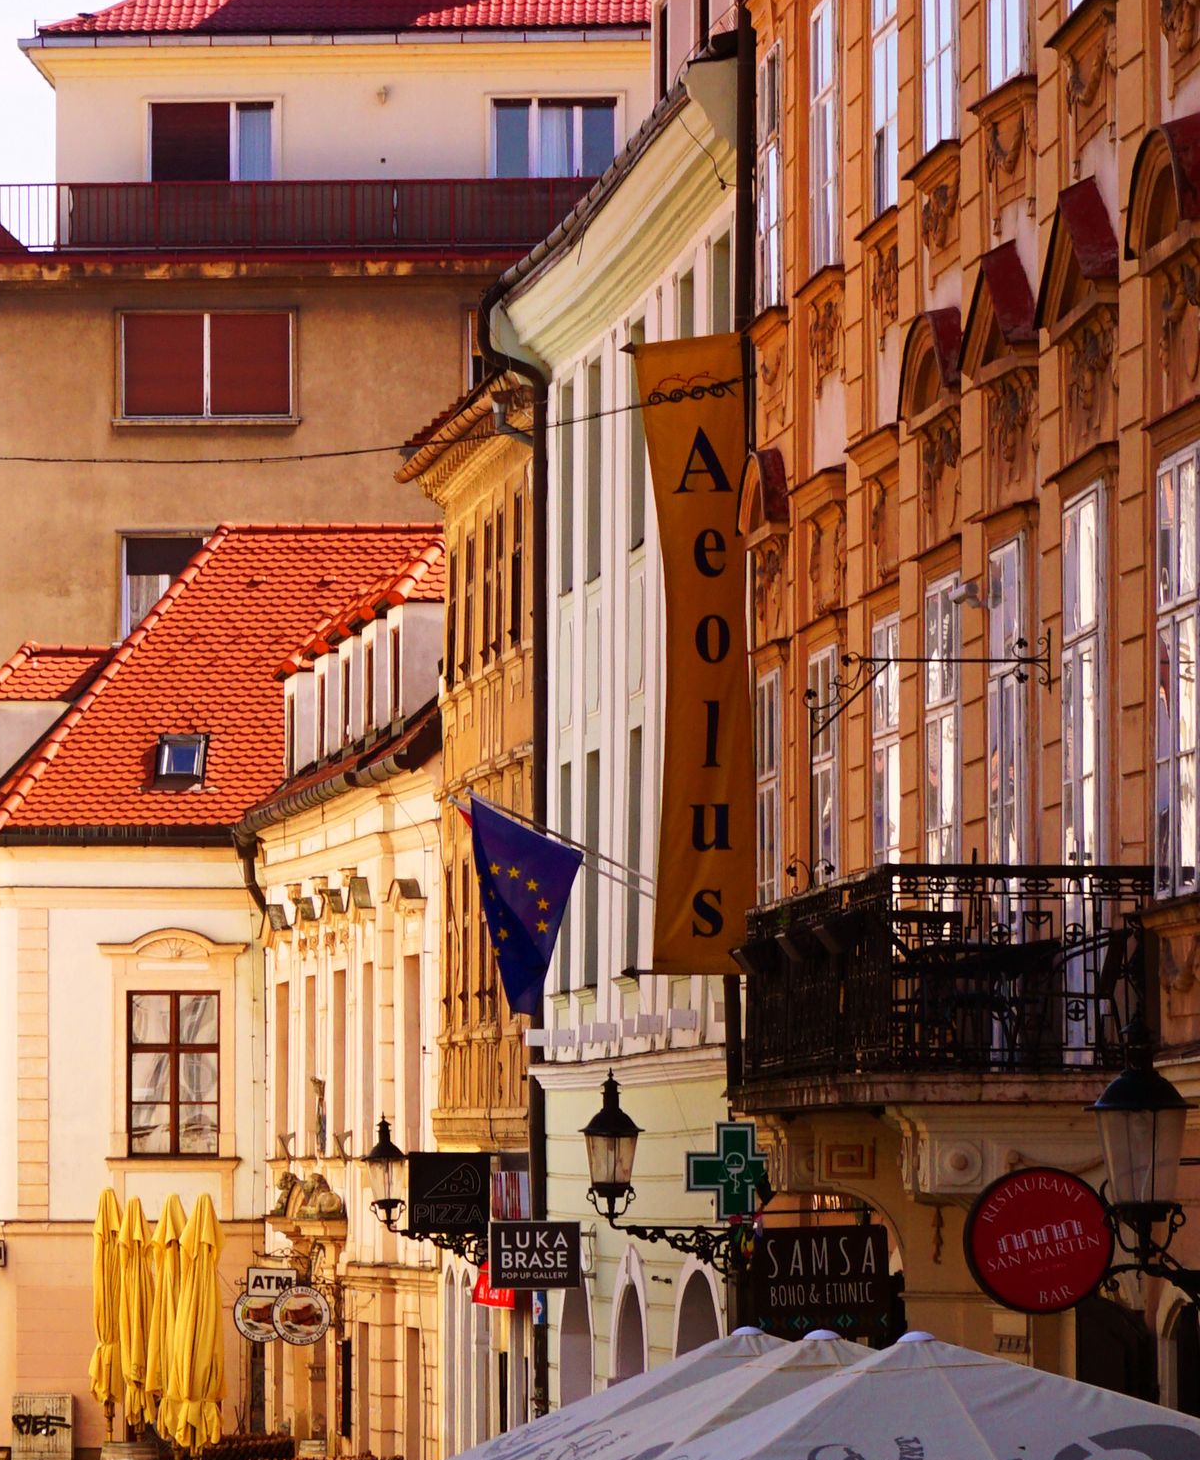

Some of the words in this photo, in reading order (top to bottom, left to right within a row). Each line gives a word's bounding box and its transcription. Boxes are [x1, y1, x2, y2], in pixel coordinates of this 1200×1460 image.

[673, 426, 733, 938] Aeolus
[982, 1176, 1086, 1223] RESTAURANT
[413, 1204, 484, 1224] PIZZA
[501, 1231, 568, 1249] LUKA
[501, 1251, 568, 1269] BRASE
[766, 1236, 876, 1279] SAMSA
[986, 1252, 1021, 1272] SAN
[1026, 1233, 1100, 1263] MARTEN
[251, 1275, 293, 1290] ATM
[501, 1272, 518, 1280] POP
[532, 1271, 569, 1280] GALLERY
[770, 1284, 806, 1307] BOHO
[809, 1283, 821, 1305] &
[826, 1281, 875, 1305] ETHNIC
[1039, 1284, 1074, 1305] BAR
